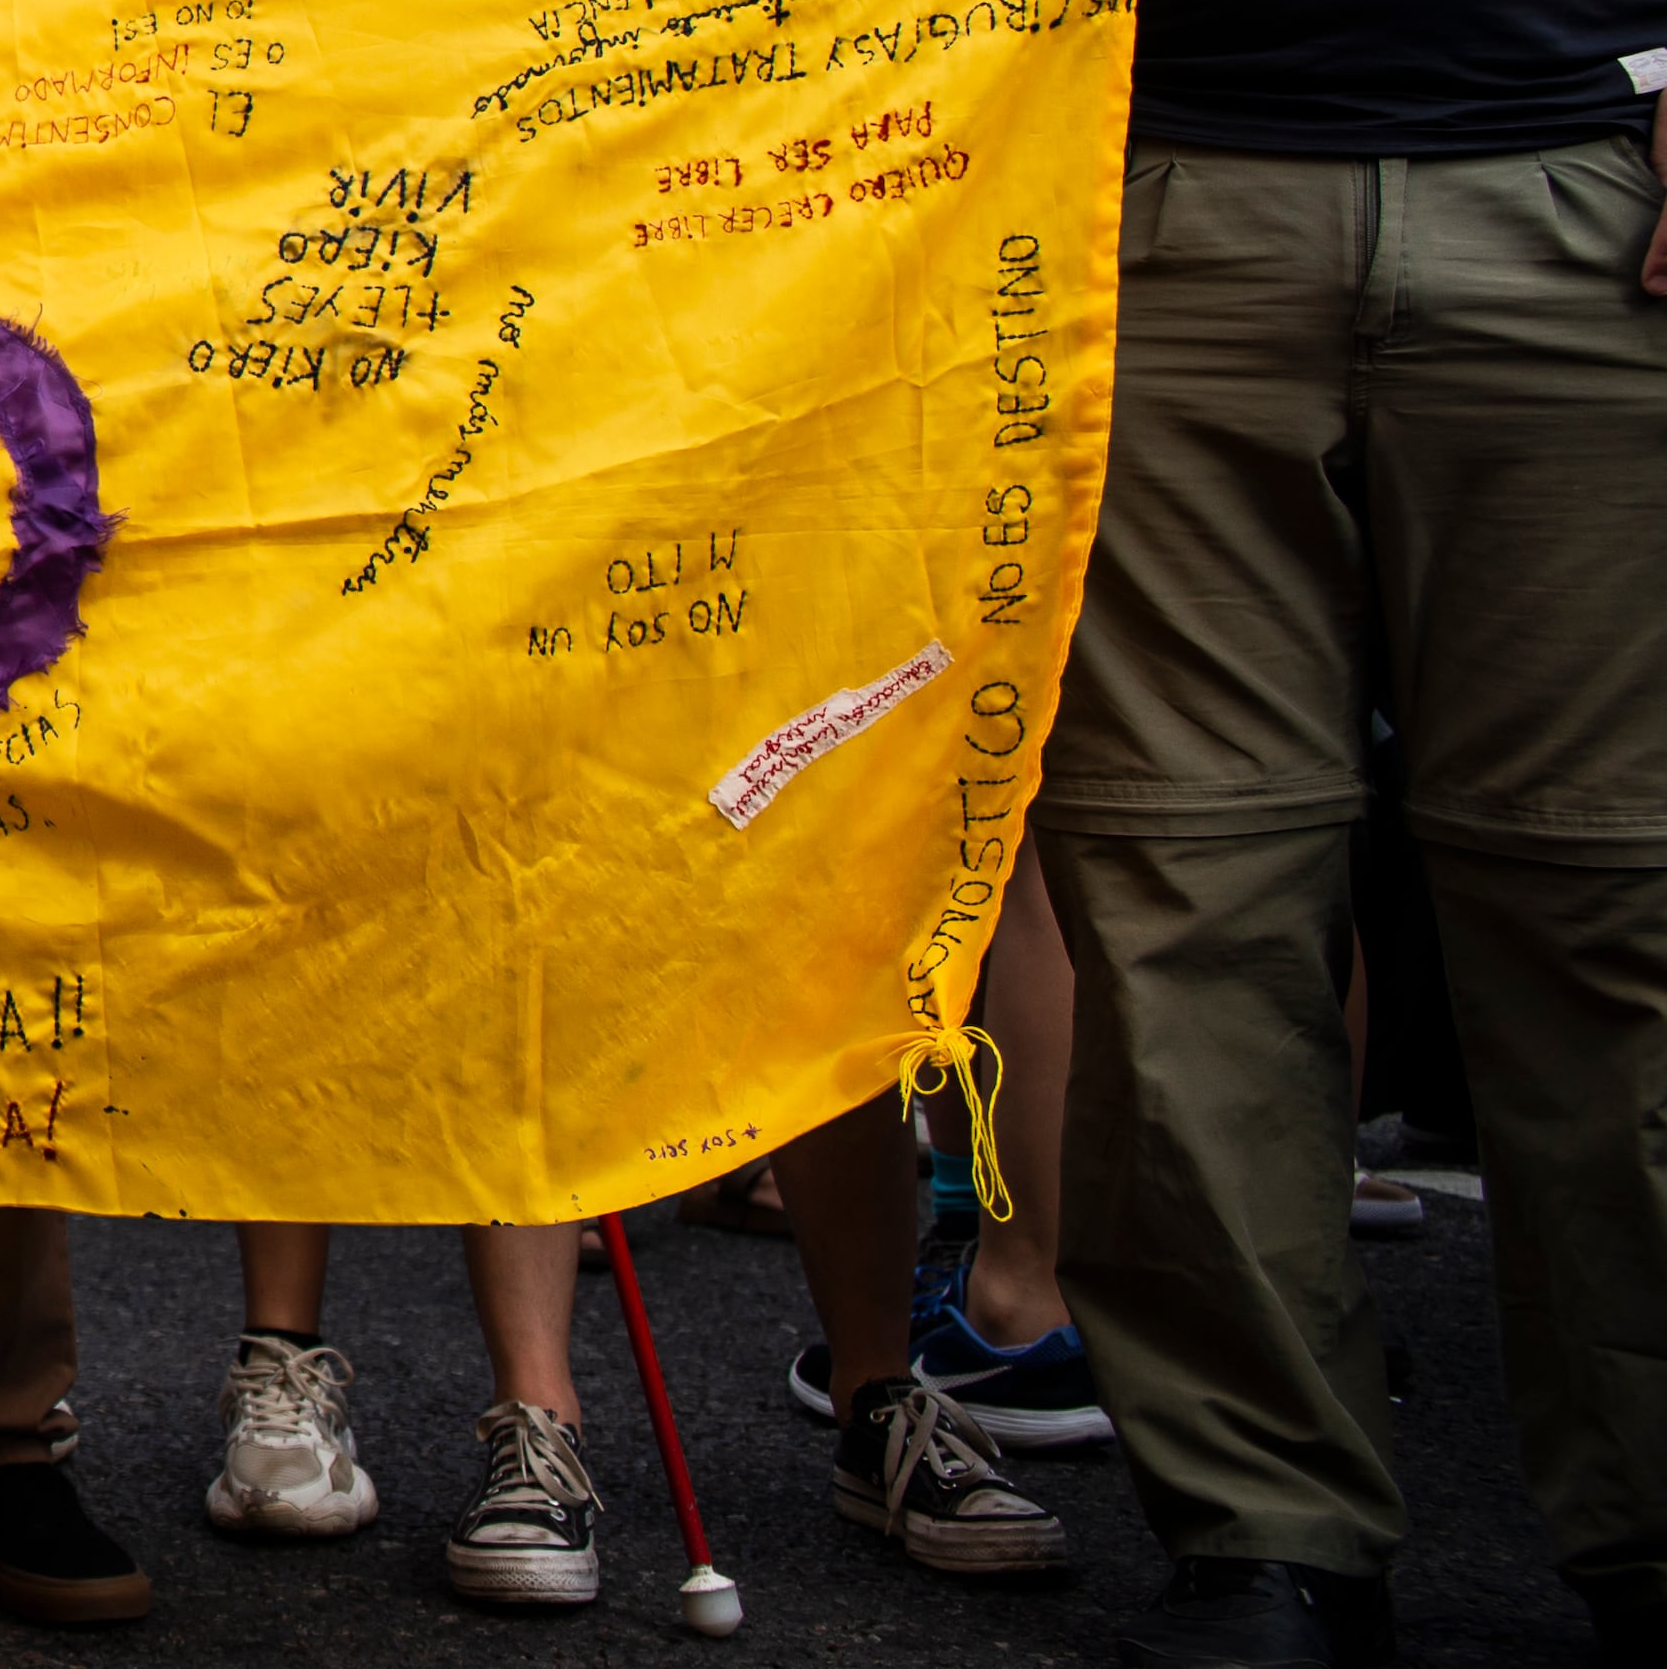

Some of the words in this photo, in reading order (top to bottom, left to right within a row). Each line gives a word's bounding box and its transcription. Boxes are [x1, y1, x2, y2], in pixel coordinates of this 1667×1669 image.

[175, 1, 213, 26] NO
[212, 38, 252, 70] ES
[849, 101, 932, 150] PARA
[767, 139, 831, 172] SER
[716, 192, 833, 233] CRECER
[350, 349, 405, 387] NO
[982, 484, 1032, 547] ES
[688, 590, 747, 634] NO
[978, 561, 1027, 625] NO
[527, 623, 572, 658] UN
[604, 611, 669, 655] SOY
